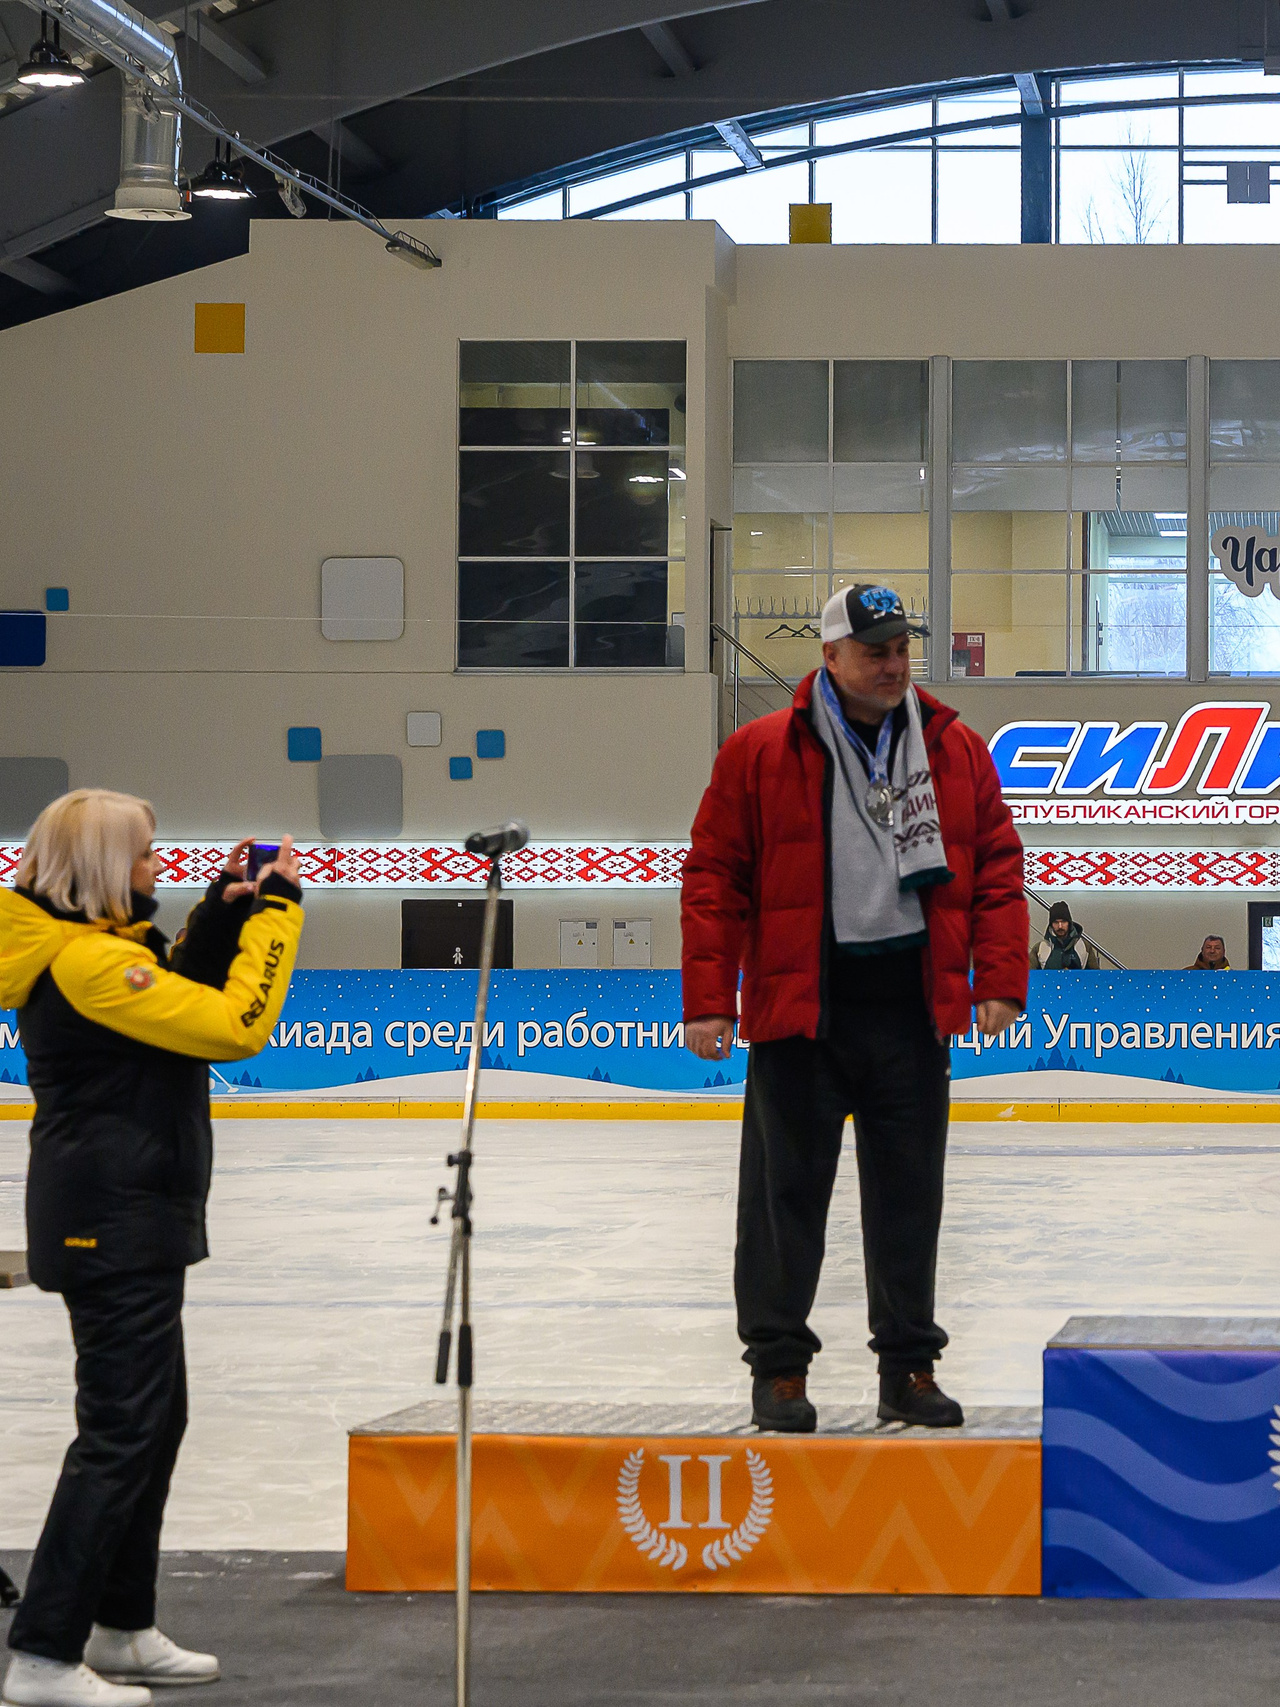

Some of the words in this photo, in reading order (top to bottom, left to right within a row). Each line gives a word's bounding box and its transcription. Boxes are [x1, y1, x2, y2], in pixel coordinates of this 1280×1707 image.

[1008, 801, 1230, 819] СПУБЛИКАНСКИЙ
[269, 1020, 373, 1055] иада
[384, 1020, 505, 1057] среди
[517, 1009, 686, 1057] работни
[950, 1012, 1032, 1056] ций
[658, 1454, 732, 1529] II
